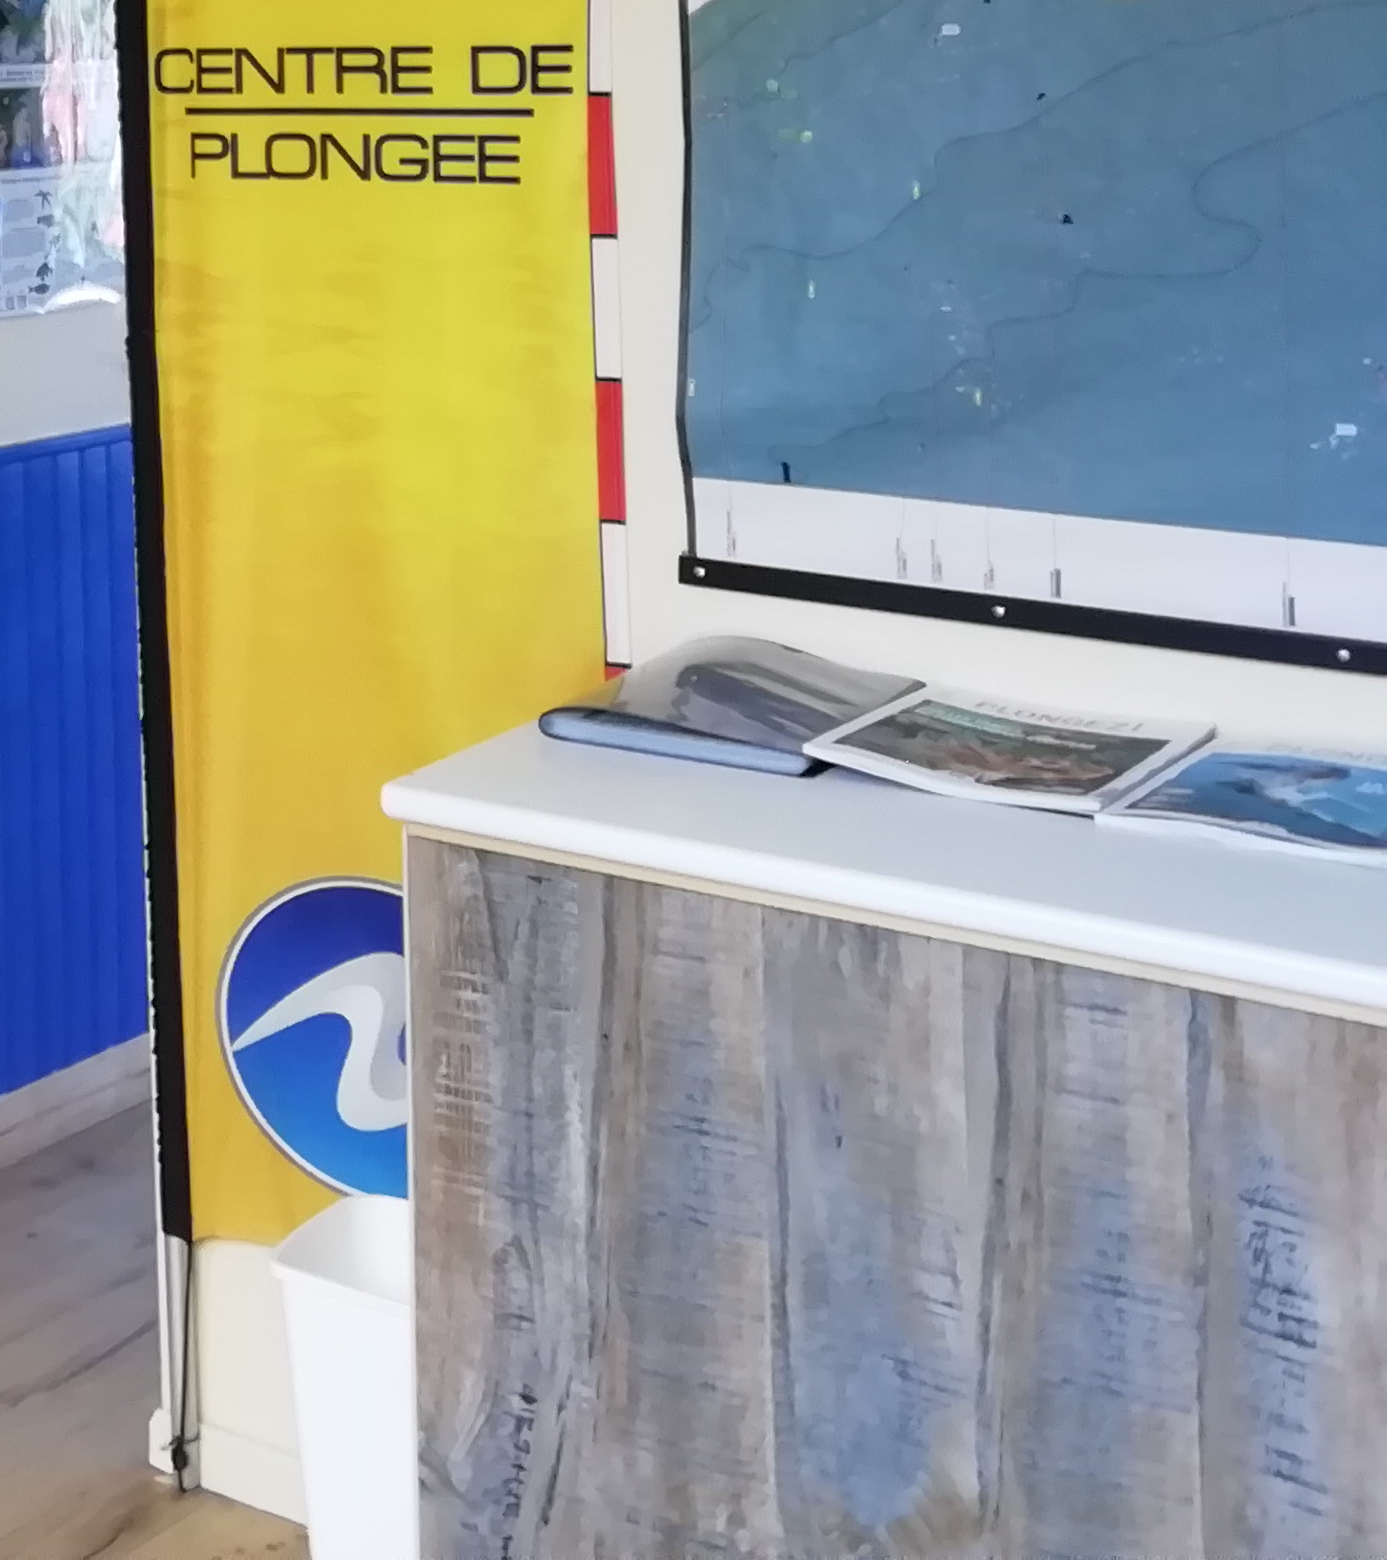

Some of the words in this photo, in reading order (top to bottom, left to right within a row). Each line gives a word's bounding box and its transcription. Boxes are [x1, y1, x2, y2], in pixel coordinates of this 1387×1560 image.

[153, 45, 434, 96] CENTRE
[470, 44, 574, 96] DE
[190, 132, 521, 185] PLONGEE
